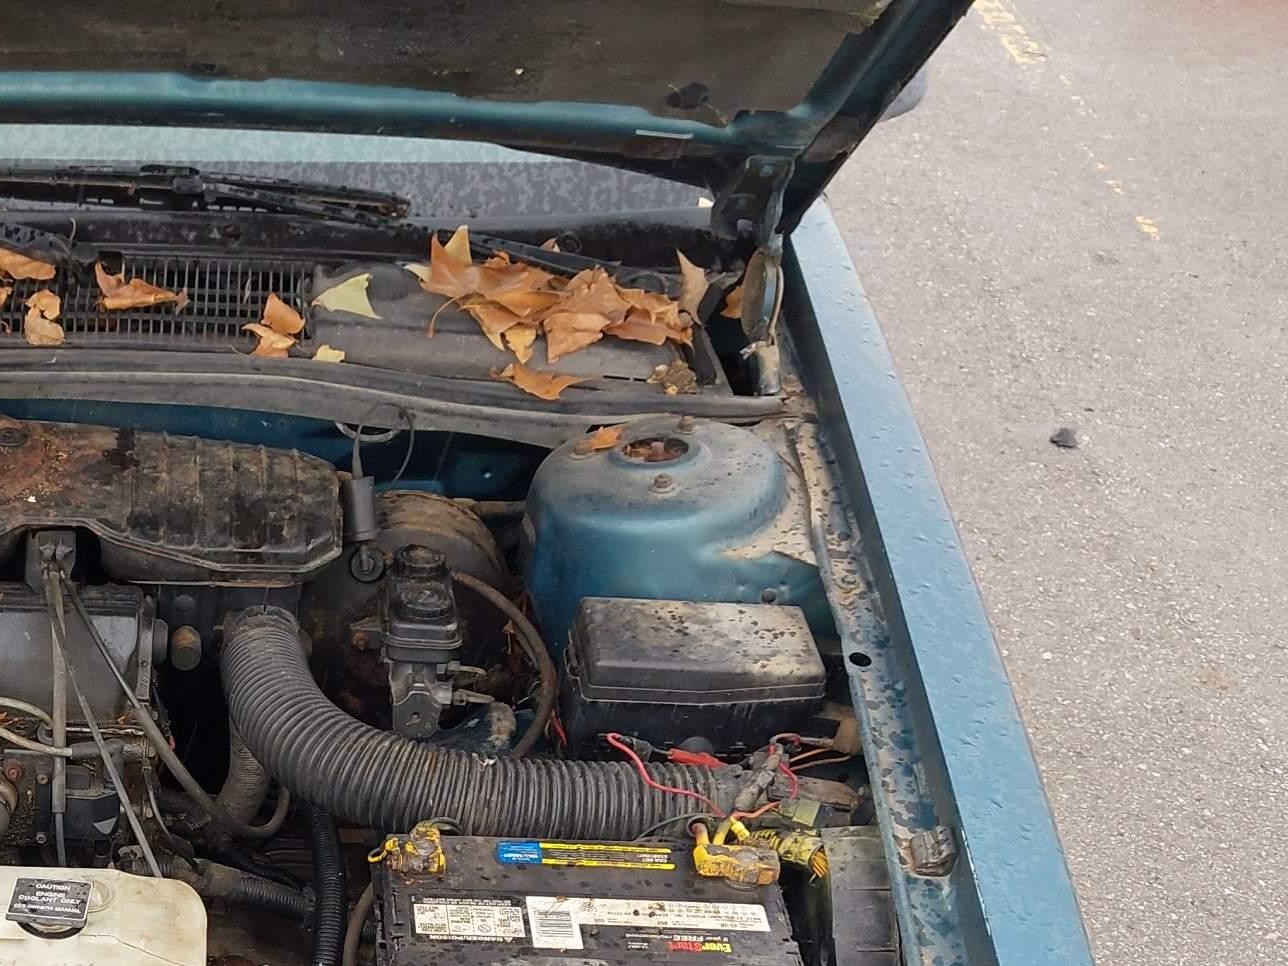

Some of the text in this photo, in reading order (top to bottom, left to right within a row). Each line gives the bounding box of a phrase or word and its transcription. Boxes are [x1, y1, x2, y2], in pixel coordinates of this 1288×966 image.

[18, 895, 57, 903] COOLANT
[429, 934, 504, 942] DANGER/POISON
[673, 934, 704, 942] FREE
[669, 941, 732, 953] EverStart
